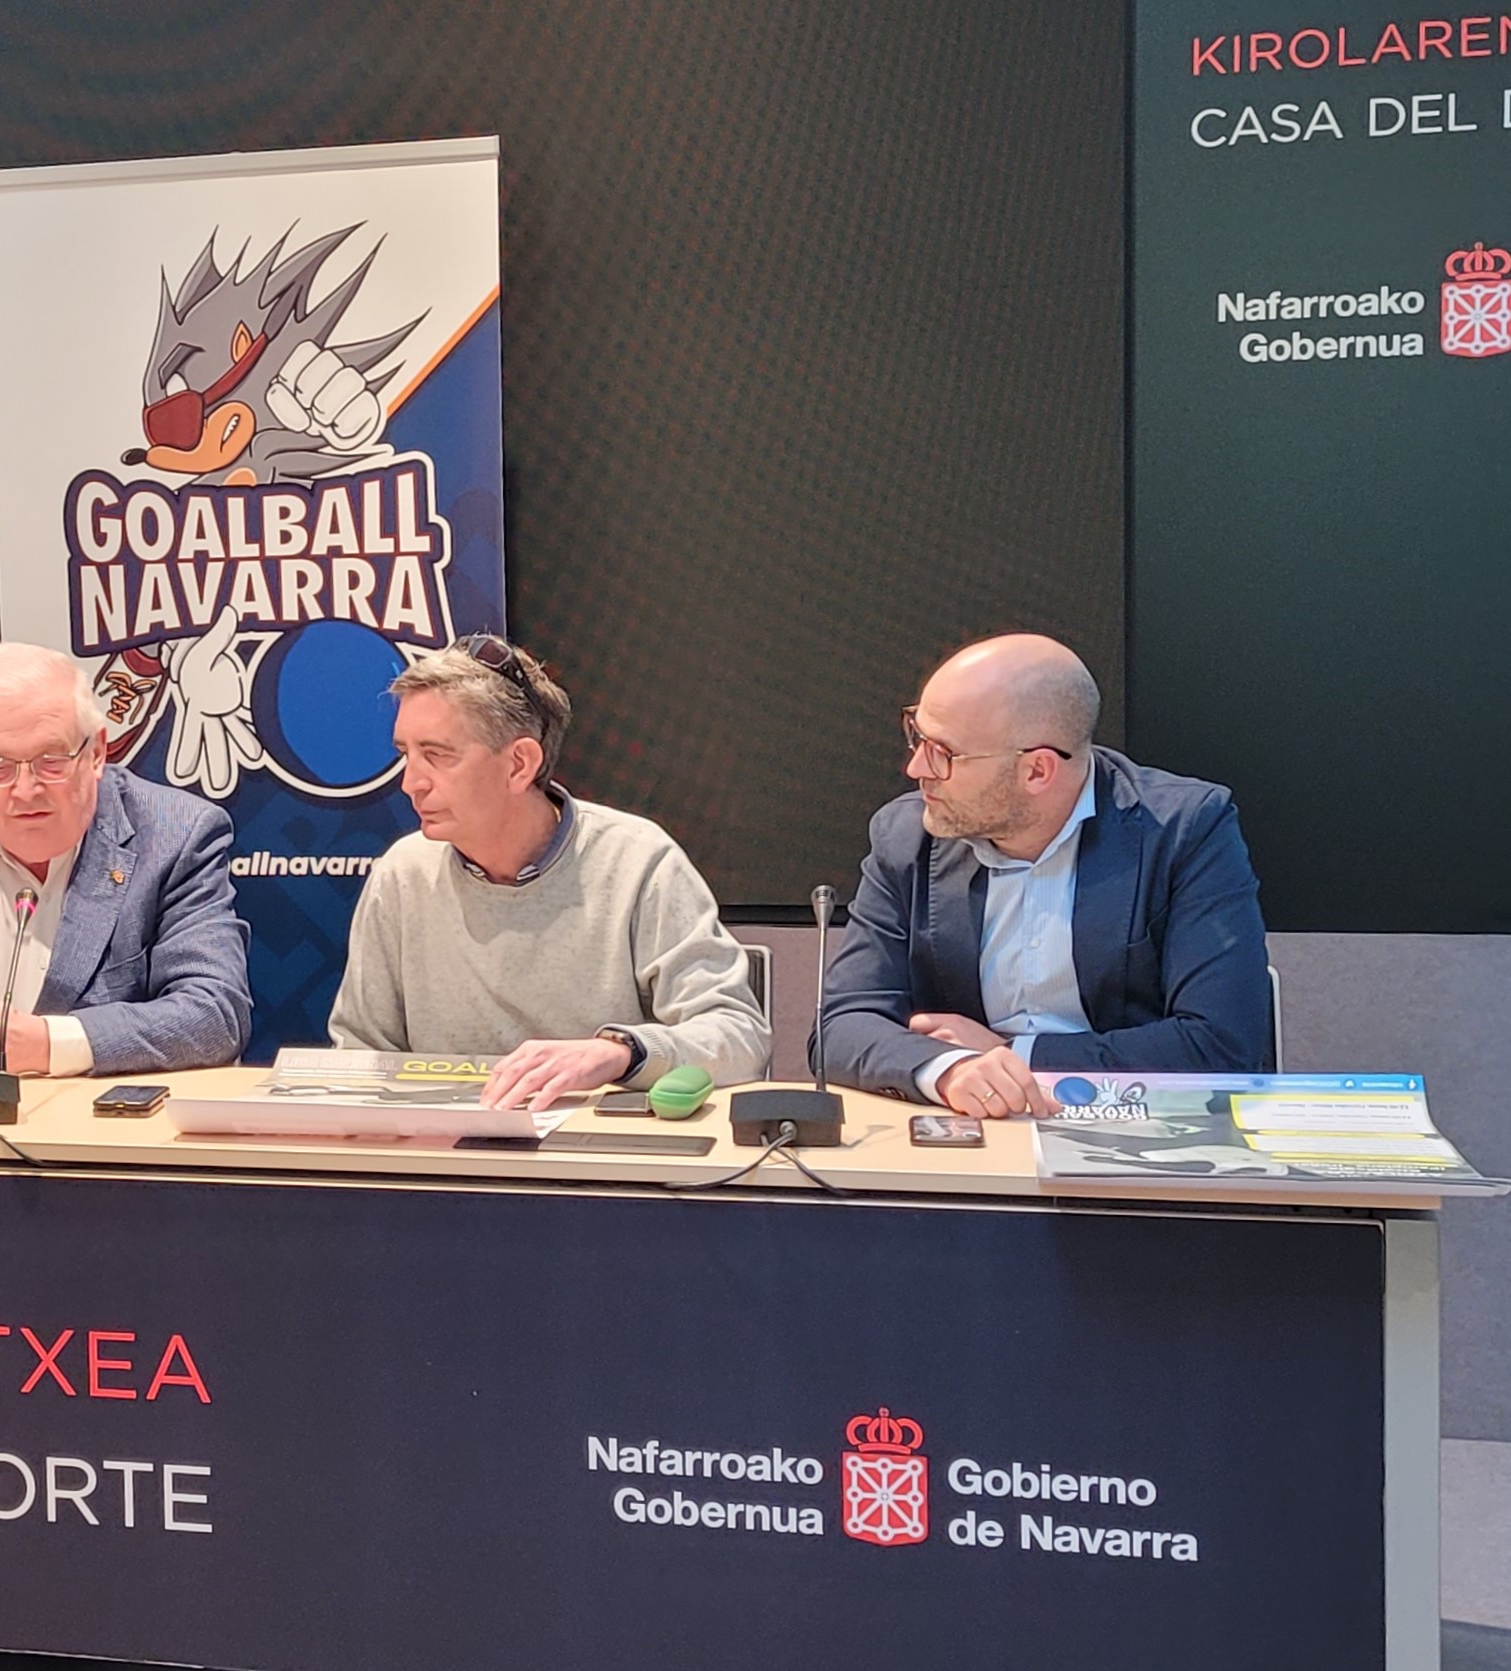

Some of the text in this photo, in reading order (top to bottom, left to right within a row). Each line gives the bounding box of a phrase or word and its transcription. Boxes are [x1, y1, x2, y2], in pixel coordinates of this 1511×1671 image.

[1190, 100, 1344, 148] CASA
[1368, 92, 1478, 137] DEL
[1217, 285, 1425, 323] Nafarroako
[1239, 331, 1424, 363] Gobernua
[76, 472, 431, 563] GOALBALL
[80, 554, 435, 646] NAVARRA
[228, 851, 382, 876] allnavarr
[587, 1435, 824, 1485] Nafarroako
[947, 1458, 1157, 1507] Gobierno
[613, 1486, 824, 1535] Gobernua
[947, 1510, 1199, 1562] de Navarra
